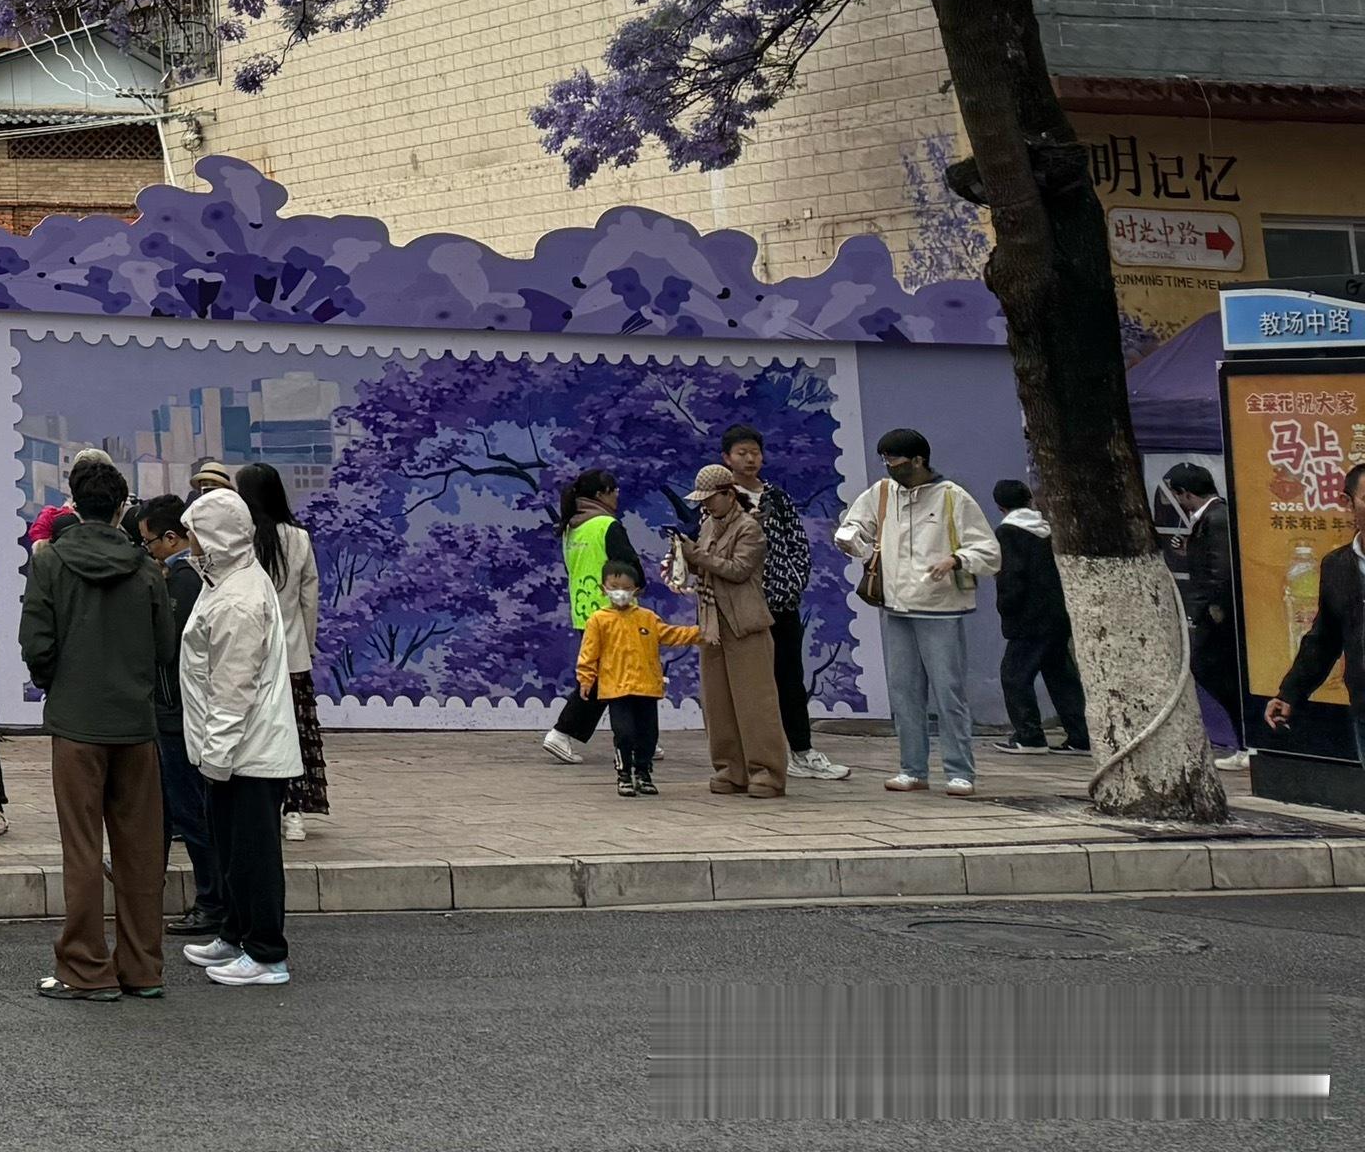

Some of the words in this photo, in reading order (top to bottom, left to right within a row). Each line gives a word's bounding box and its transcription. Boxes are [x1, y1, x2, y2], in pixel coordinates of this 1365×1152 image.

[1114, 214, 1204, 246] 时光中路
[1164, 274, 1194, 288] TIME
[1259, 308, 1351, 337] 教场中路
[1246, 392, 1294, 414] 金菜花
[1295, 390, 1358, 416] 祝大家
[1268, 419, 1343, 474] 马上
[1270, 501, 1304, 513] 2026
